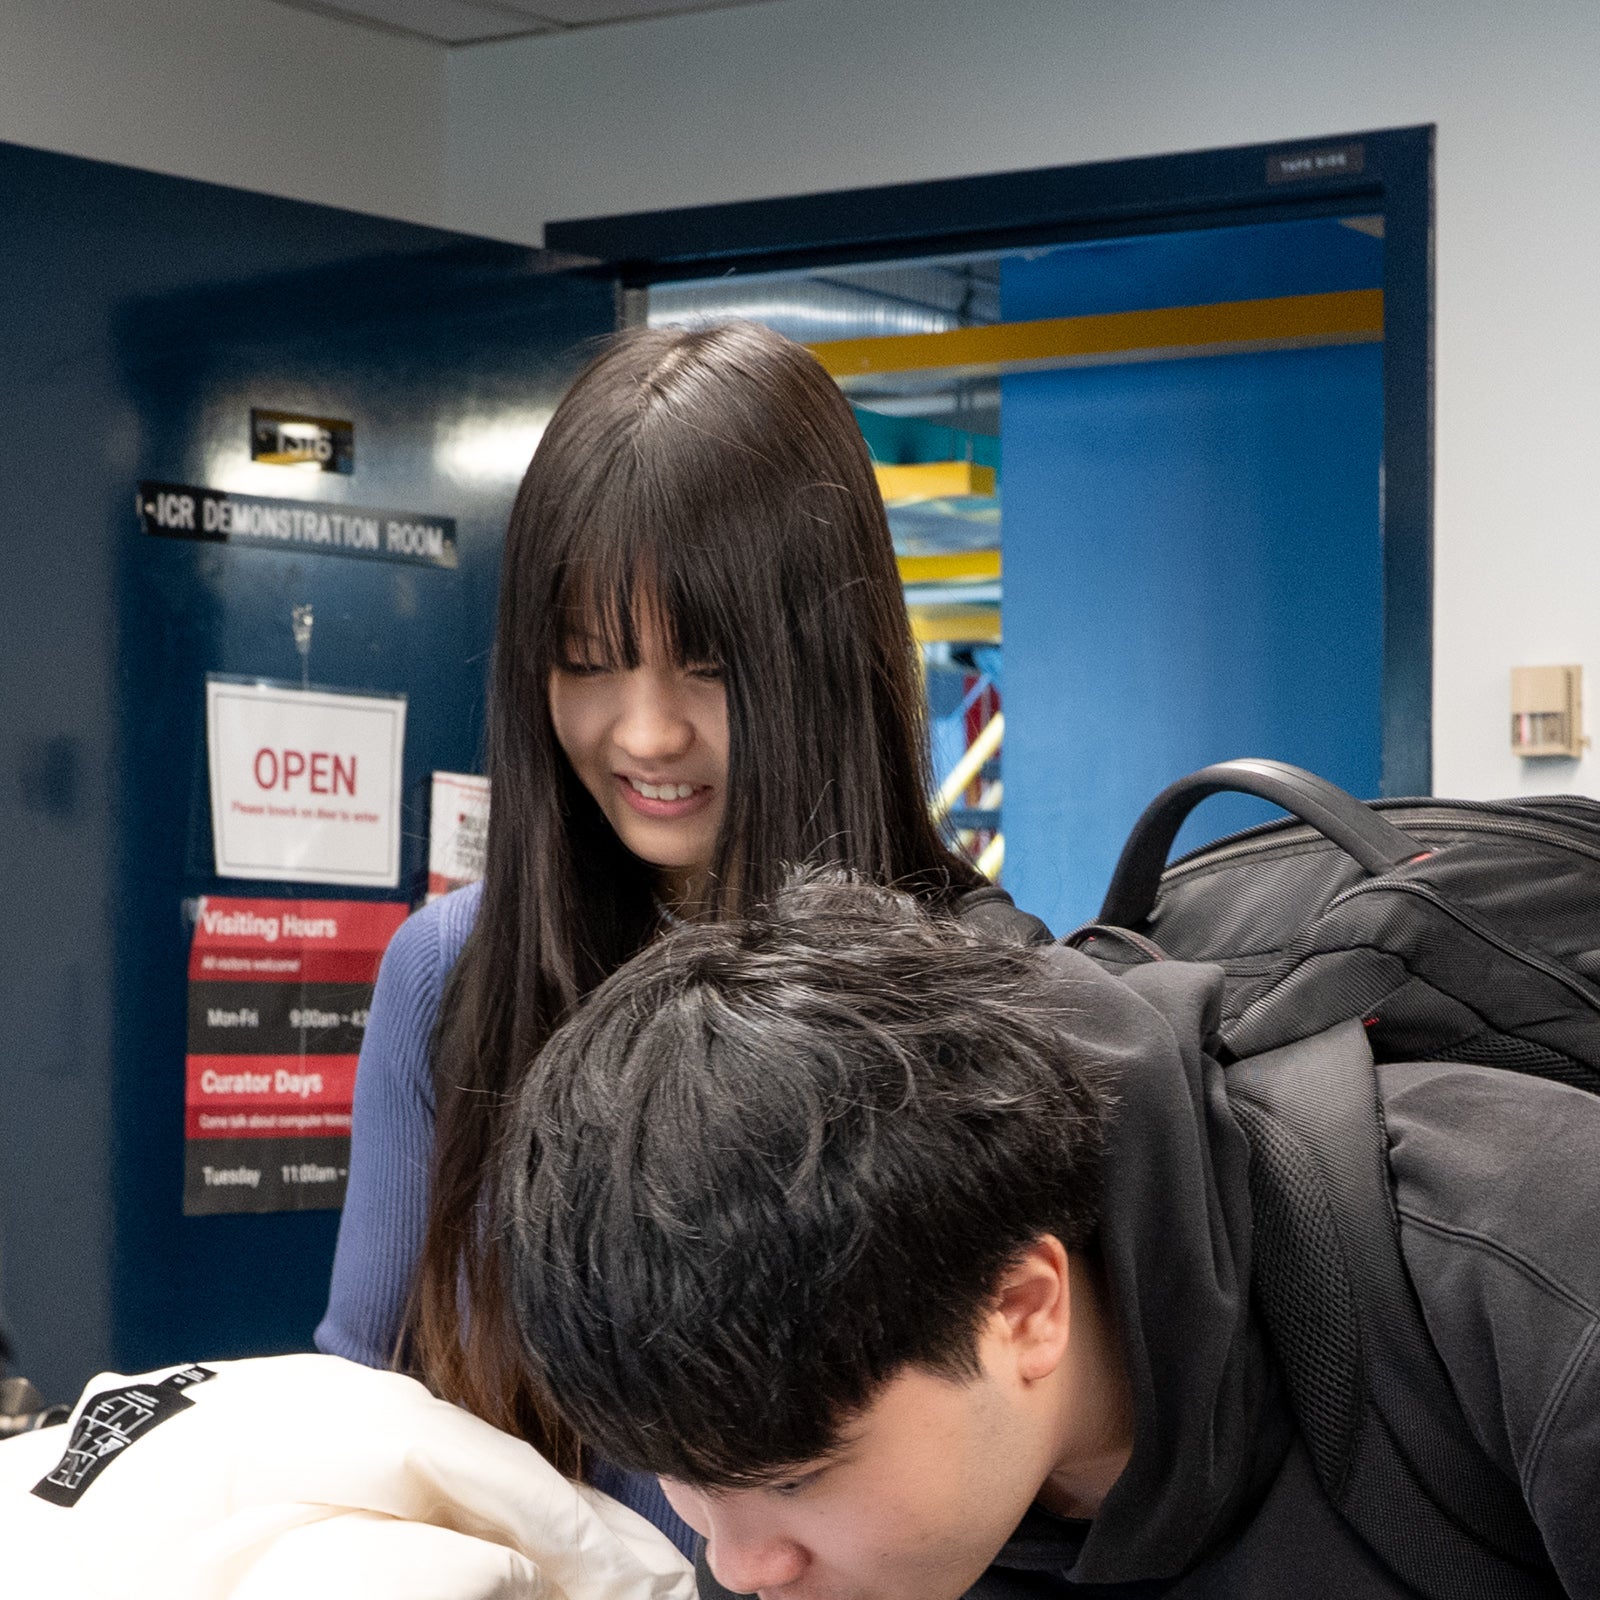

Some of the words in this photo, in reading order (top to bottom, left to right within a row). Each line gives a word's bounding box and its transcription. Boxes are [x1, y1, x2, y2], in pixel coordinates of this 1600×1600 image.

[203, 499, 380, 551] DEMONSTRATION
[386, 520, 444, 556] ROOM
[254, 747, 357, 797] OPEN
[203, 911, 279, 942] Visiting
[282, 915, 338, 938] Hours
[289, 1010, 340, 1028] 9:00am
[201, 1071, 271, 1093] Curator
[275, 1070, 322, 1097] Days
[203, 1166, 261, 1188] Tuesday
[282, 1164, 337, 1183] 11:00am
